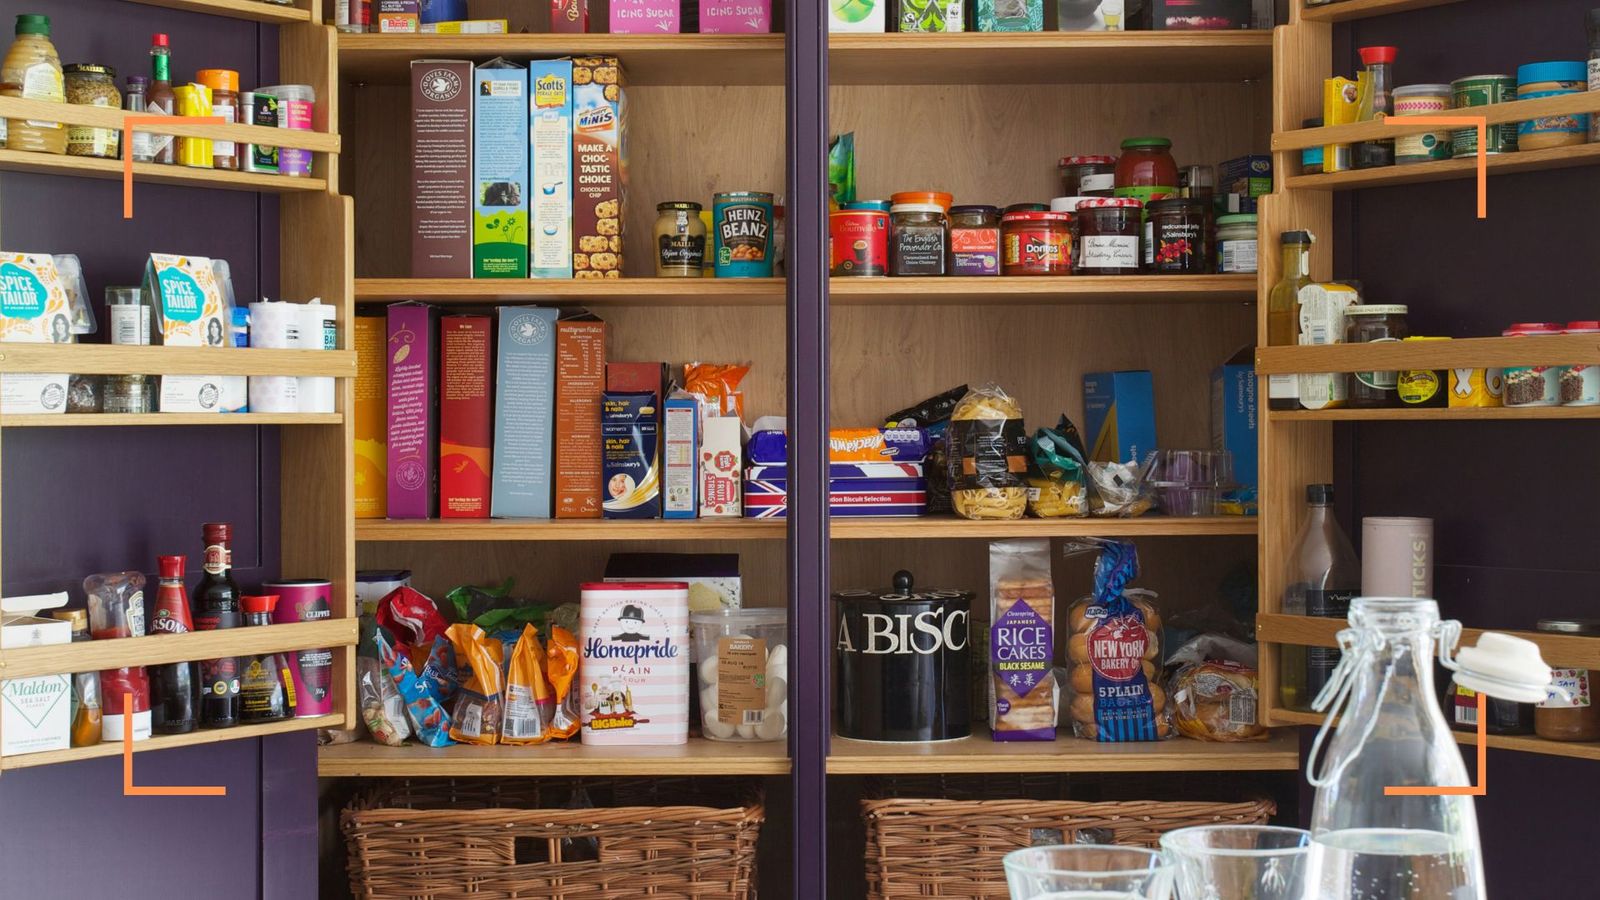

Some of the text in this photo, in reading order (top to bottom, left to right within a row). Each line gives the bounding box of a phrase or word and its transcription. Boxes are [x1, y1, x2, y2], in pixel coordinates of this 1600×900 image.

[617, 7, 674, 18] ICING SUGAR
[707, 6, 764, 17] ICING SUGAR
[423, 70, 460, 87] DOVES FARM
[425, 88, 458, 100] ORGANIC
[578, 144, 613, 153] MAKE A
[581, 154, 610, 163] CHOC-
[580, 165, 611, 174] TASTIC
[579, 175, 612, 184] CHOICE
[728, 209, 762, 222] HEINZ
[722, 221, 768, 239] BEANZ
[903, 233, 938, 245] The English
[899, 242, 932, 252] Provender
[1026, 244, 1058, 253] Doritos
[0, 275, 35, 291] SPICE
[162, 279, 195, 296] SPICE
[0, 290, 39, 306] TAILOR
[165, 294, 198, 309] TAILOR
[707, 474, 716, 506] STRINGS
[717, 480, 725, 501] FRUIT
[836, 606, 970, 655] A BISC
[997, 627, 1047, 646] RICE
[584, 637, 679, 664] Homepride
[997, 646, 1046, 661] CAKES
[1094, 640, 1145, 659] NEW YORK
[612, 664, 651, 675] PLAIN
[999, 662, 1045, 671] BLACK SESAME
[1101, 658, 1129, 670] BAKERY
[9, 680, 62, 697] Maldon
[1099, 684, 1144, 697] 5 PLAIN
[1557, 680, 1576, 688] JAM
